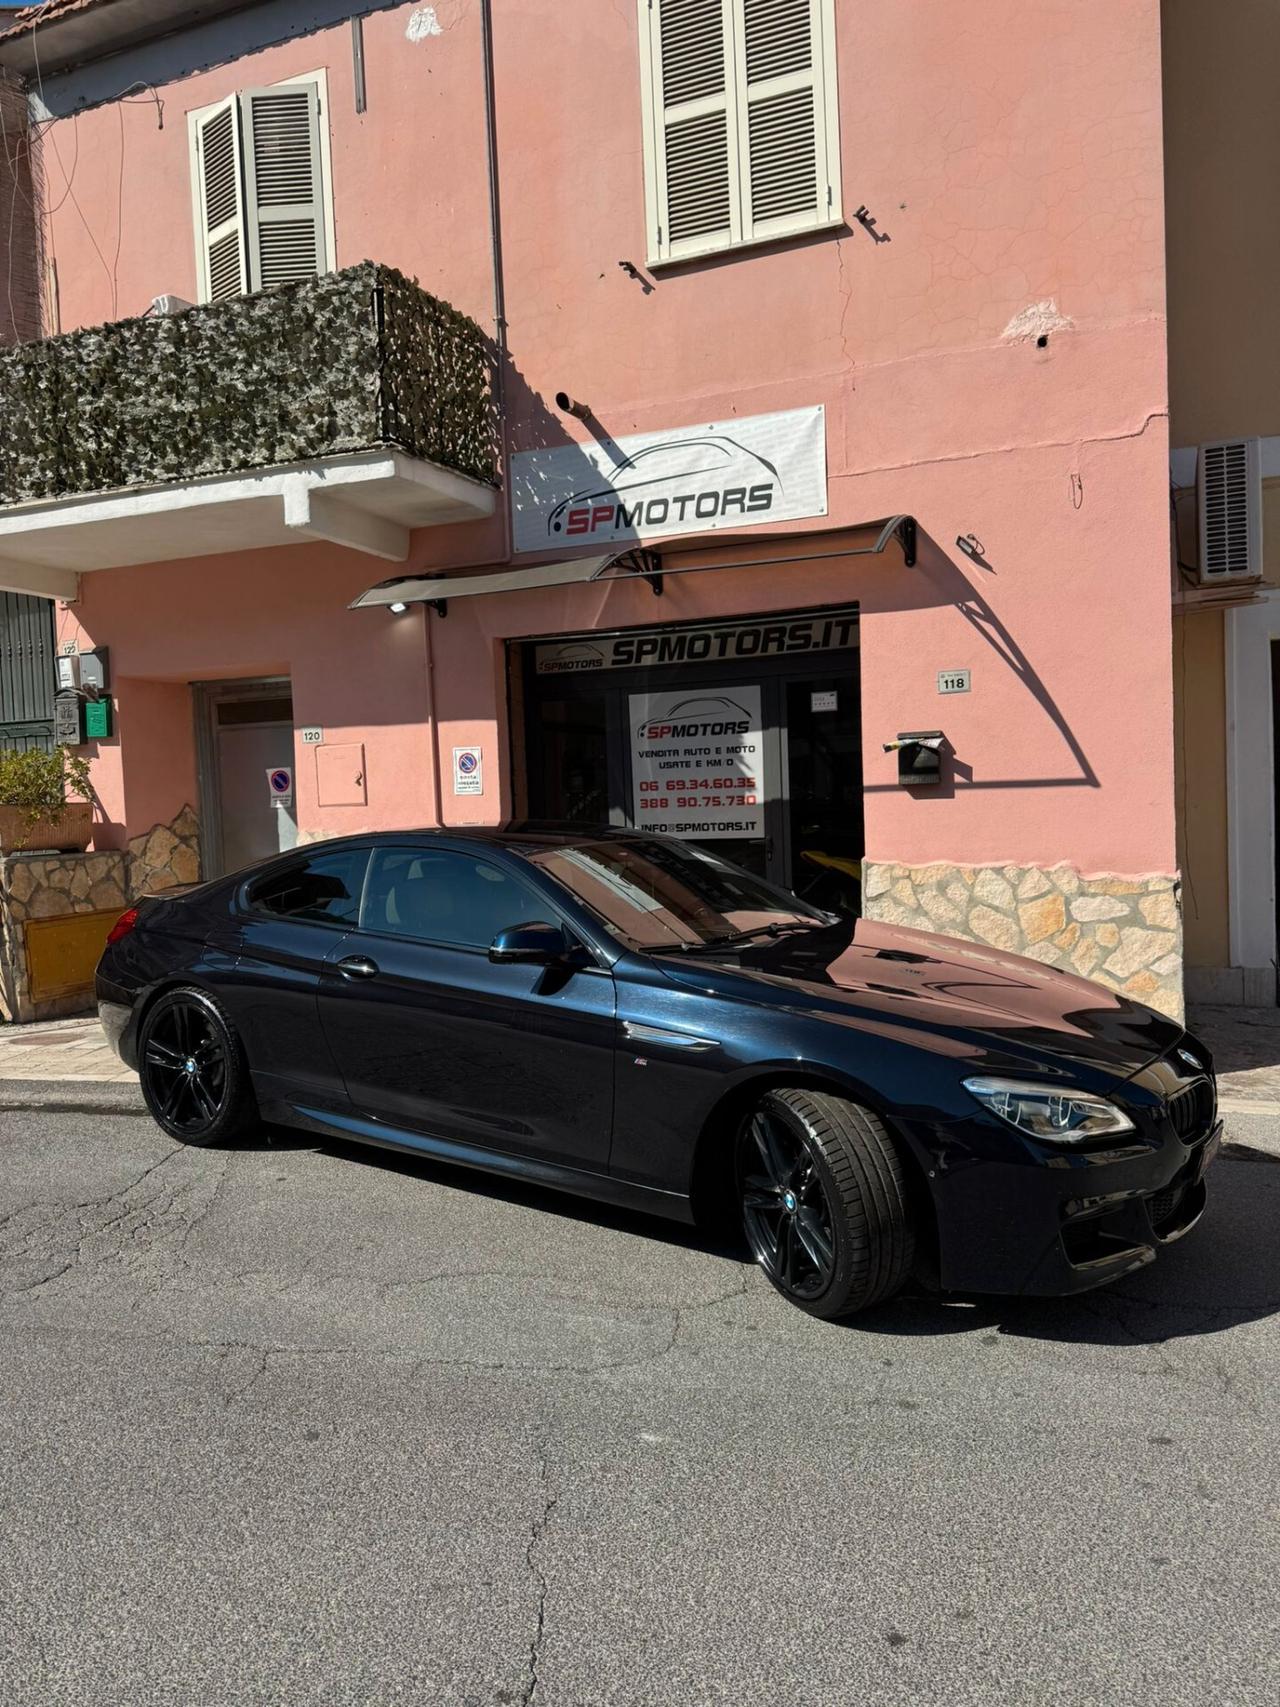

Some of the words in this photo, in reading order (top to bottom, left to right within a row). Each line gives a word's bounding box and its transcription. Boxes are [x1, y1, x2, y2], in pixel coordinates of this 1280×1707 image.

[566, 483, 773, 535] SPMOTORS
[611, 619, 858, 666] SPMOTORS.IT
[544, 658, 603, 672] SPMOTORS
[944, 678, 965, 689] 118
[304, 732, 320, 741] 120
[647, 721, 749, 739] SPMOTORS
[638, 749, 680, 759] VENDITA
[684, 747, 711, 756] AUTO
[715, 746, 722, 754] E
[726, 745, 756, 754] MOTO
[659, 760, 692, 769] USATE
[696, 759, 702, 768] E
[706, 758, 723, 767] KM
[639, 781, 659, 792] 06
[666, 777, 756, 791] 69.34.60.35
[640, 798, 669, 809] 388
[677, 795, 757, 808] 90.75.730
